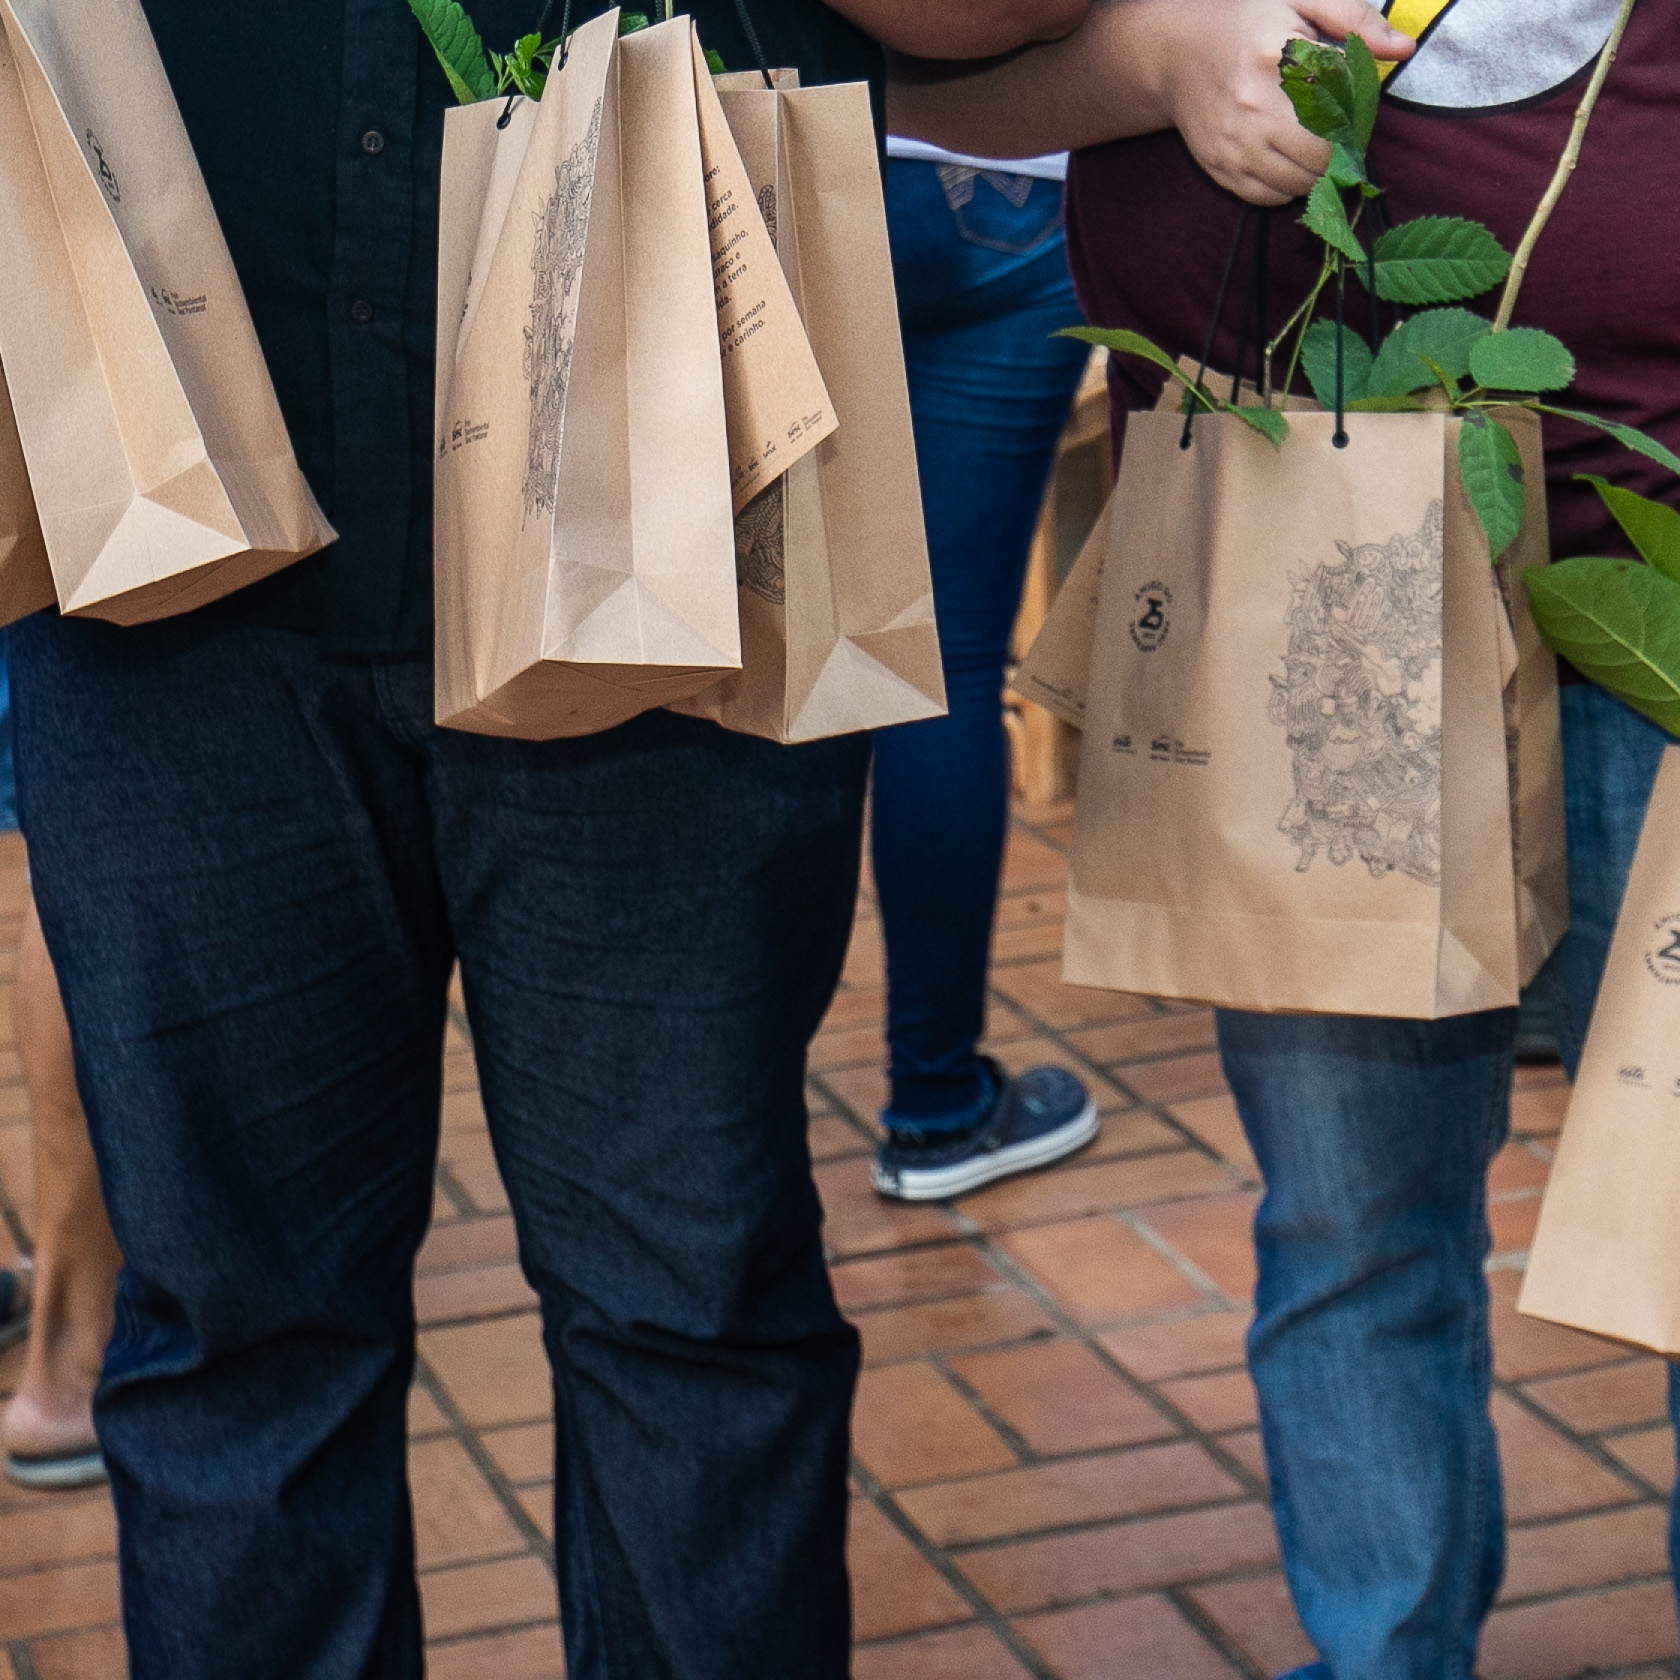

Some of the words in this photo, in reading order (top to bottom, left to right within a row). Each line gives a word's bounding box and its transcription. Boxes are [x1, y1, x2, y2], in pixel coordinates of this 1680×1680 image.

[711, 189, 733, 211] cerca
[728, 263, 748, 283] terra
[721, 323, 735, 342] por
[736, 300, 766, 328] semana
[734, 319, 766, 347] carinho.
